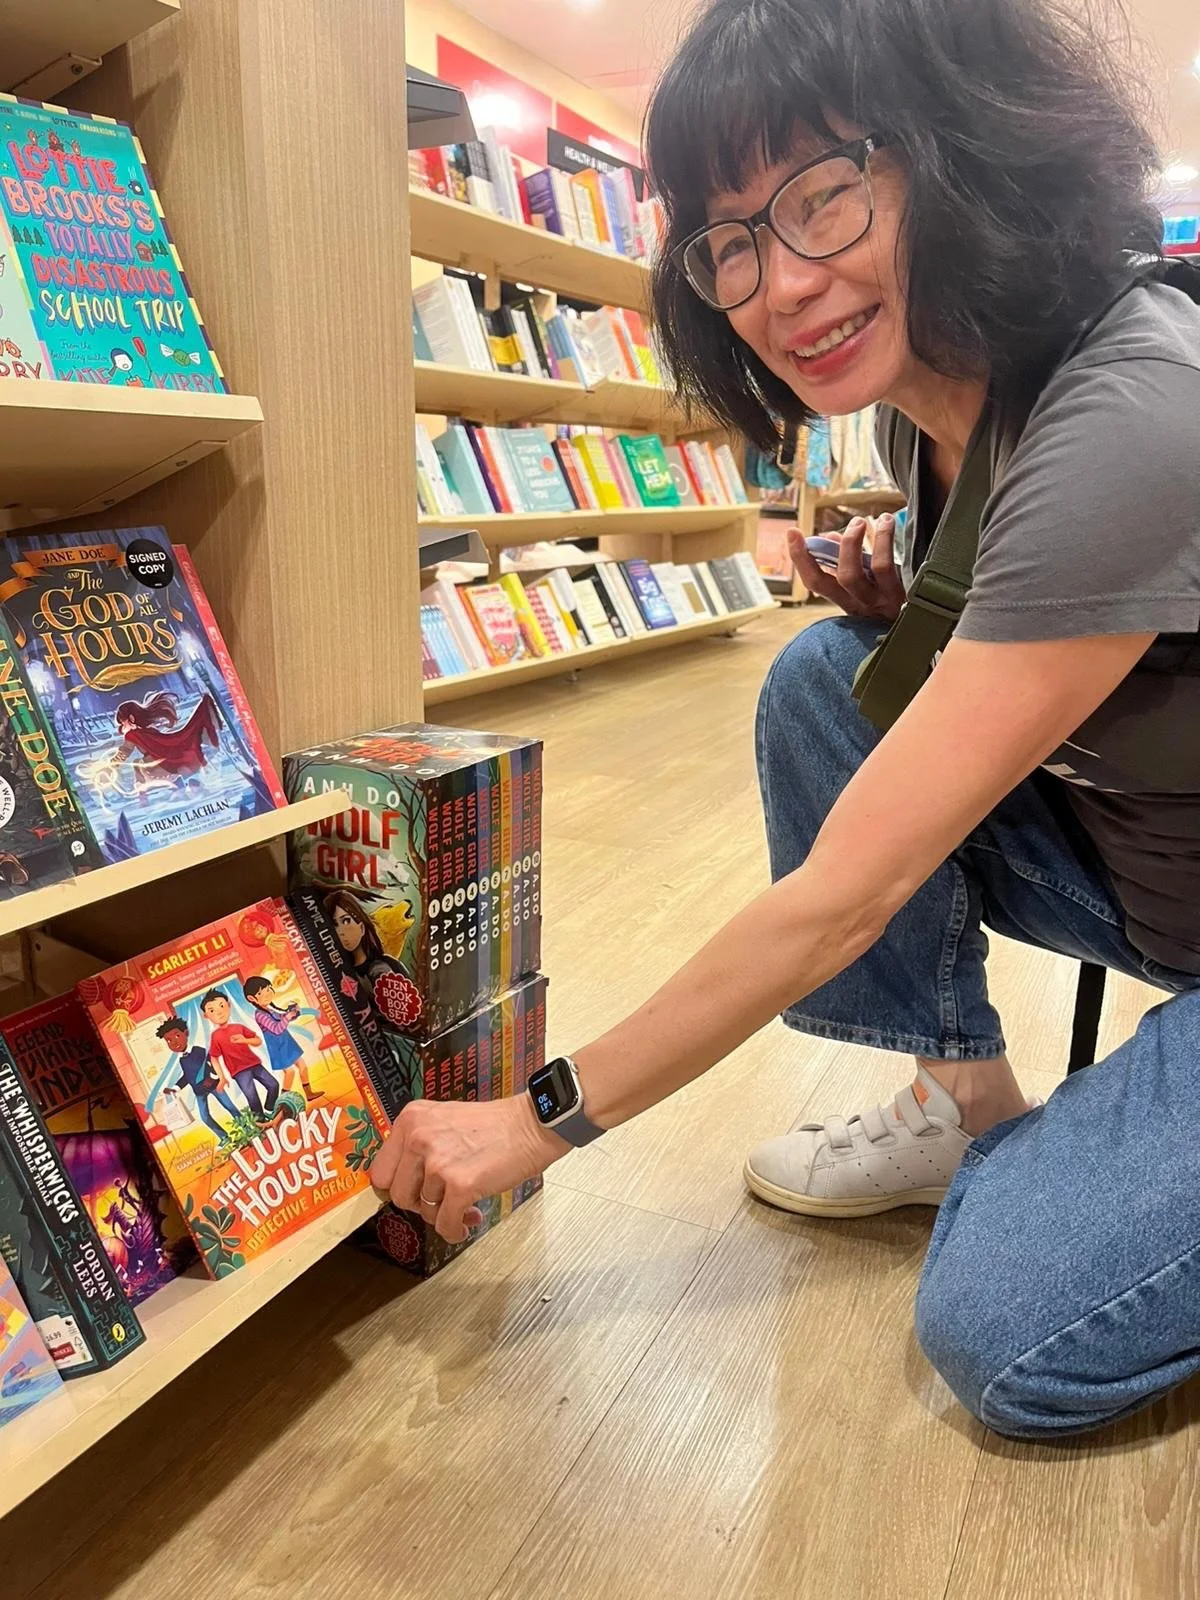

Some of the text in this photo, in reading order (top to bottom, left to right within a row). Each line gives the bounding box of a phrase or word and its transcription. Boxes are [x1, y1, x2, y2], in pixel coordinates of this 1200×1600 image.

[7, 140, 126, 195] LOTTIE
[1, 177, 155, 234] BROOKS'S
[44, 222, 134, 263] TOTALLY
[32, 253, 175, 299] DISASTROUS
[40, 290, 184, 334] SCHOOL TRIP
[152, 372, 218, 393] KIRBY
[43, 549, 106, 564] JANE DOE
[129, 552, 166, 564] SIGNED
[138, 564, 166, 575] COPY
[70, 569, 104, 591] The
[33, 586, 135, 631] GOD
[135, 592, 151, 604] OF
[139, 604, 159, 617] ALL
[40, 618, 178, 691] HOURS
[18, 729, 75, 819] DOE
[389, 763, 435, 775] DO
[367, 786, 400, 808] DO
[491, 783, 499, 825] WOLF
[523, 771, 531, 812] WOLF
[142, 814, 183, 837] JEREMY
[185, 799, 230, 822] LACHLAN
[429, 807, 438, 852] WOLF
[442, 801, 452, 845] WOLF
[455, 797, 464, 840] WOLF
[467, 792, 476, 836] WOLF
[317, 844, 387, 890] GIRL
[429, 858, 438, 895] GIRL
[443, 852, 452, 889] GIRL
[455, 847, 464, 884] GIRL
[468, 842, 476, 879] GIRL
[503, 890, 509, 904] A.
[514, 885, 520, 898] A.
[523, 880, 530, 893] A.
[533, 874, 539, 887] A.
[301, 895, 325, 928] JAMIE
[469, 908, 476, 922] A.
[481, 902, 488, 916] A.
[492, 896, 499, 910] A.
[514, 902, 520, 926] DO
[523, 898, 530, 920] DO
[533, 891, 539, 914] DO
[430, 925, 439, 940] A.
[444, 920, 452, 935] A.
[456, 914, 464, 928] A.
[481, 920, 488, 944] DO
[492, 914, 499, 938] DO
[503, 908, 510, 932] DO
[444, 938, 452, 964] DO
[456, 932, 464, 958] DO
[469, 926, 477, 951] DO
[148, 941, 209, 979] SCARLETT
[211, 934, 227, 950] LI
[430, 944, 439, 970] DO
[382, 987, 412, 1003] BOOK
[385, 978, 408, 992] TEN
[281, 913, 307, 953] LUCKY
[300, 956, 325, 996] HOUSE
[319, 996, 346, 1043] DETECTIVE
[342, 1045, 365, 1080] AGENCY
[363, 1085, 381, 1115] SCARLETT
[387, 998, 408, 1012] BOX
[389, 1008, 408, 1020] SET
[15, 1022, 64, 1056] EGEND
[526, 1009, 534, 1076] WOLF GIR
[536, 1001, 544, 1068] WOLF GIR
[353, 1001, 410, 1103] ARKSPIRE
[467, 1043, 476, 1084] WOLF
[492, 1030, 500, 1101] WOLF GIR
[425, 1067, 436, 1101] WOL
[454, 1051, 463, 1093] WOLF
[0, 1062, 22, 1101] THE
[12, 1095, 80, 1224] WHISPERWICKS
[231, 1106, 342, 1181] LUCKY
[6, 1118, 36, 1174] IMPOSSIBLE
[34, 1175, 53, 1207] TRIALS
[212, 1171, 248, 1206] THE
[233, 1146, 338, 1228] HOUSE
[246, 1172, 360, 1252] DETECTIVE AGENCY
[389, 1219, 408, 1233] TEN
[385, 1225, 411, 1244] BOOK
[72, 1259, 98, 1299] LEES
[80, 1240, 116, 1302] JORDAN
